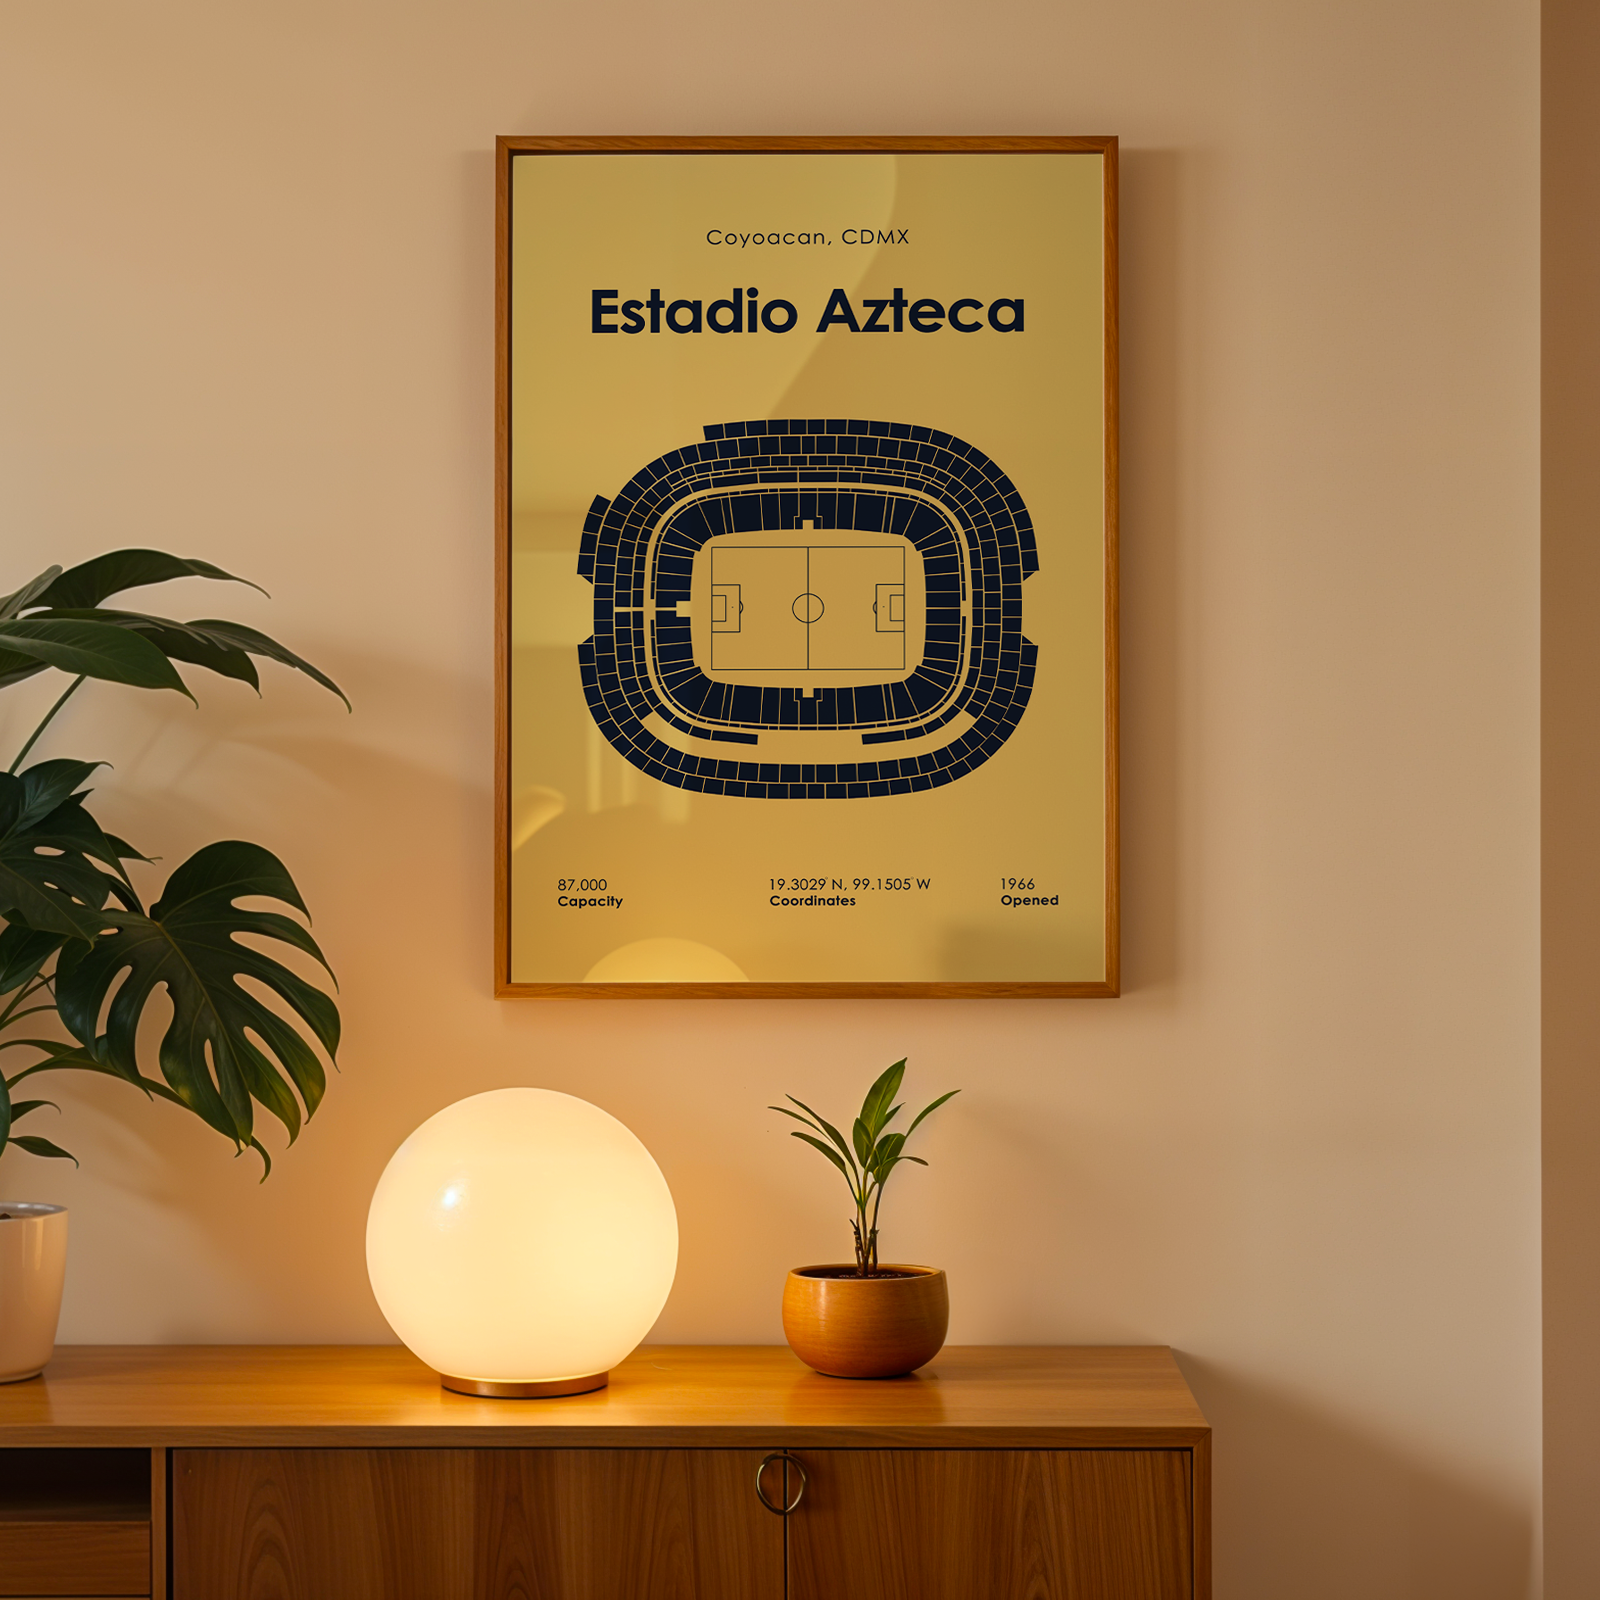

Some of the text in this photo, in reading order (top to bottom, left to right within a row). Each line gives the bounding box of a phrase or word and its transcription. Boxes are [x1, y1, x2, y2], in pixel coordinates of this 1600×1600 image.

[706, 229, 910, 249] Coyoacan, CDMX
[591, 286, 1025, 335] Estadio Azteca
[557, 878, 608, 892] 87,000
[831, 878, 848, 892] N,
[916, 878, 932, 891] W
[1000, 877, 1036, 891] 1966
[557, 895, 624, 910] Capacity
[769, 894, 857, 907] Coordinates
[1000, 894, 1059, 909] Opened
